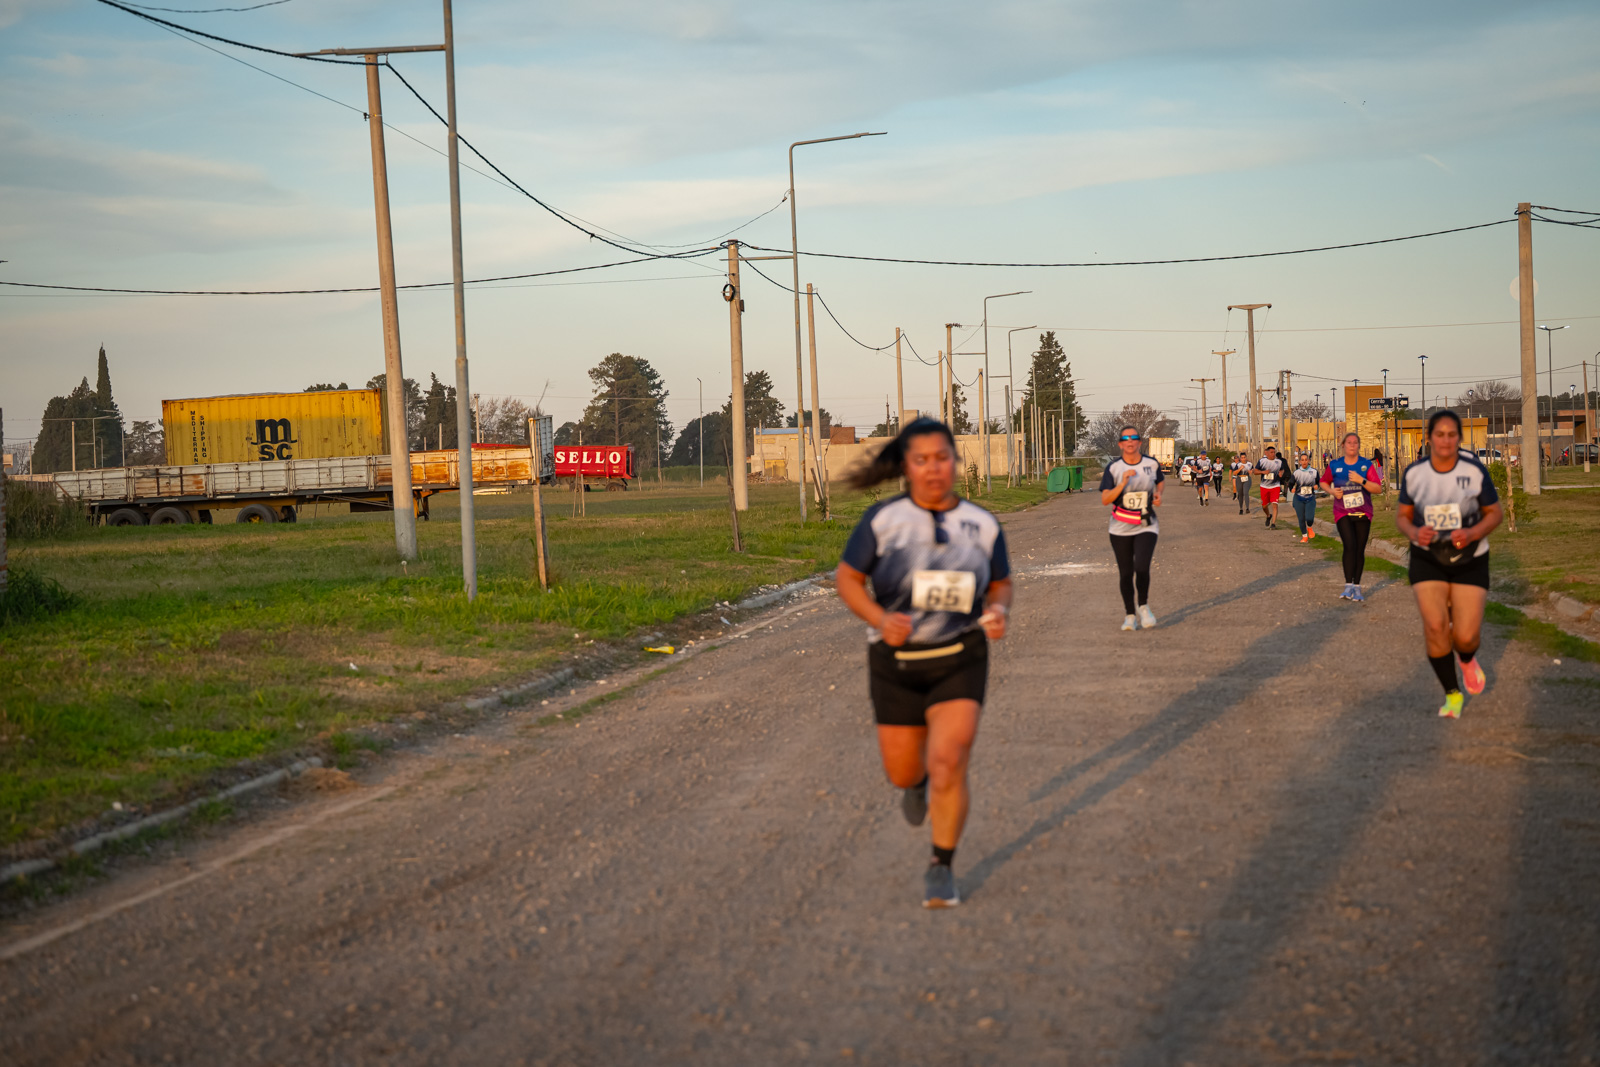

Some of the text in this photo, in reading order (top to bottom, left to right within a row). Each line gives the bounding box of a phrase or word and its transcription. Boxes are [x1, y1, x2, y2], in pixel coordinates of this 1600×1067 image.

[190, 410, 199, 465] MEDITERRAN
[555, 451, 621, 464] SELLO
[1128, 497, 1143, 508] 97
[1344, 497, 1363, 508] 543
[1427, 512, 1459, 529] 525
[926, 585, 959, 609] 65
